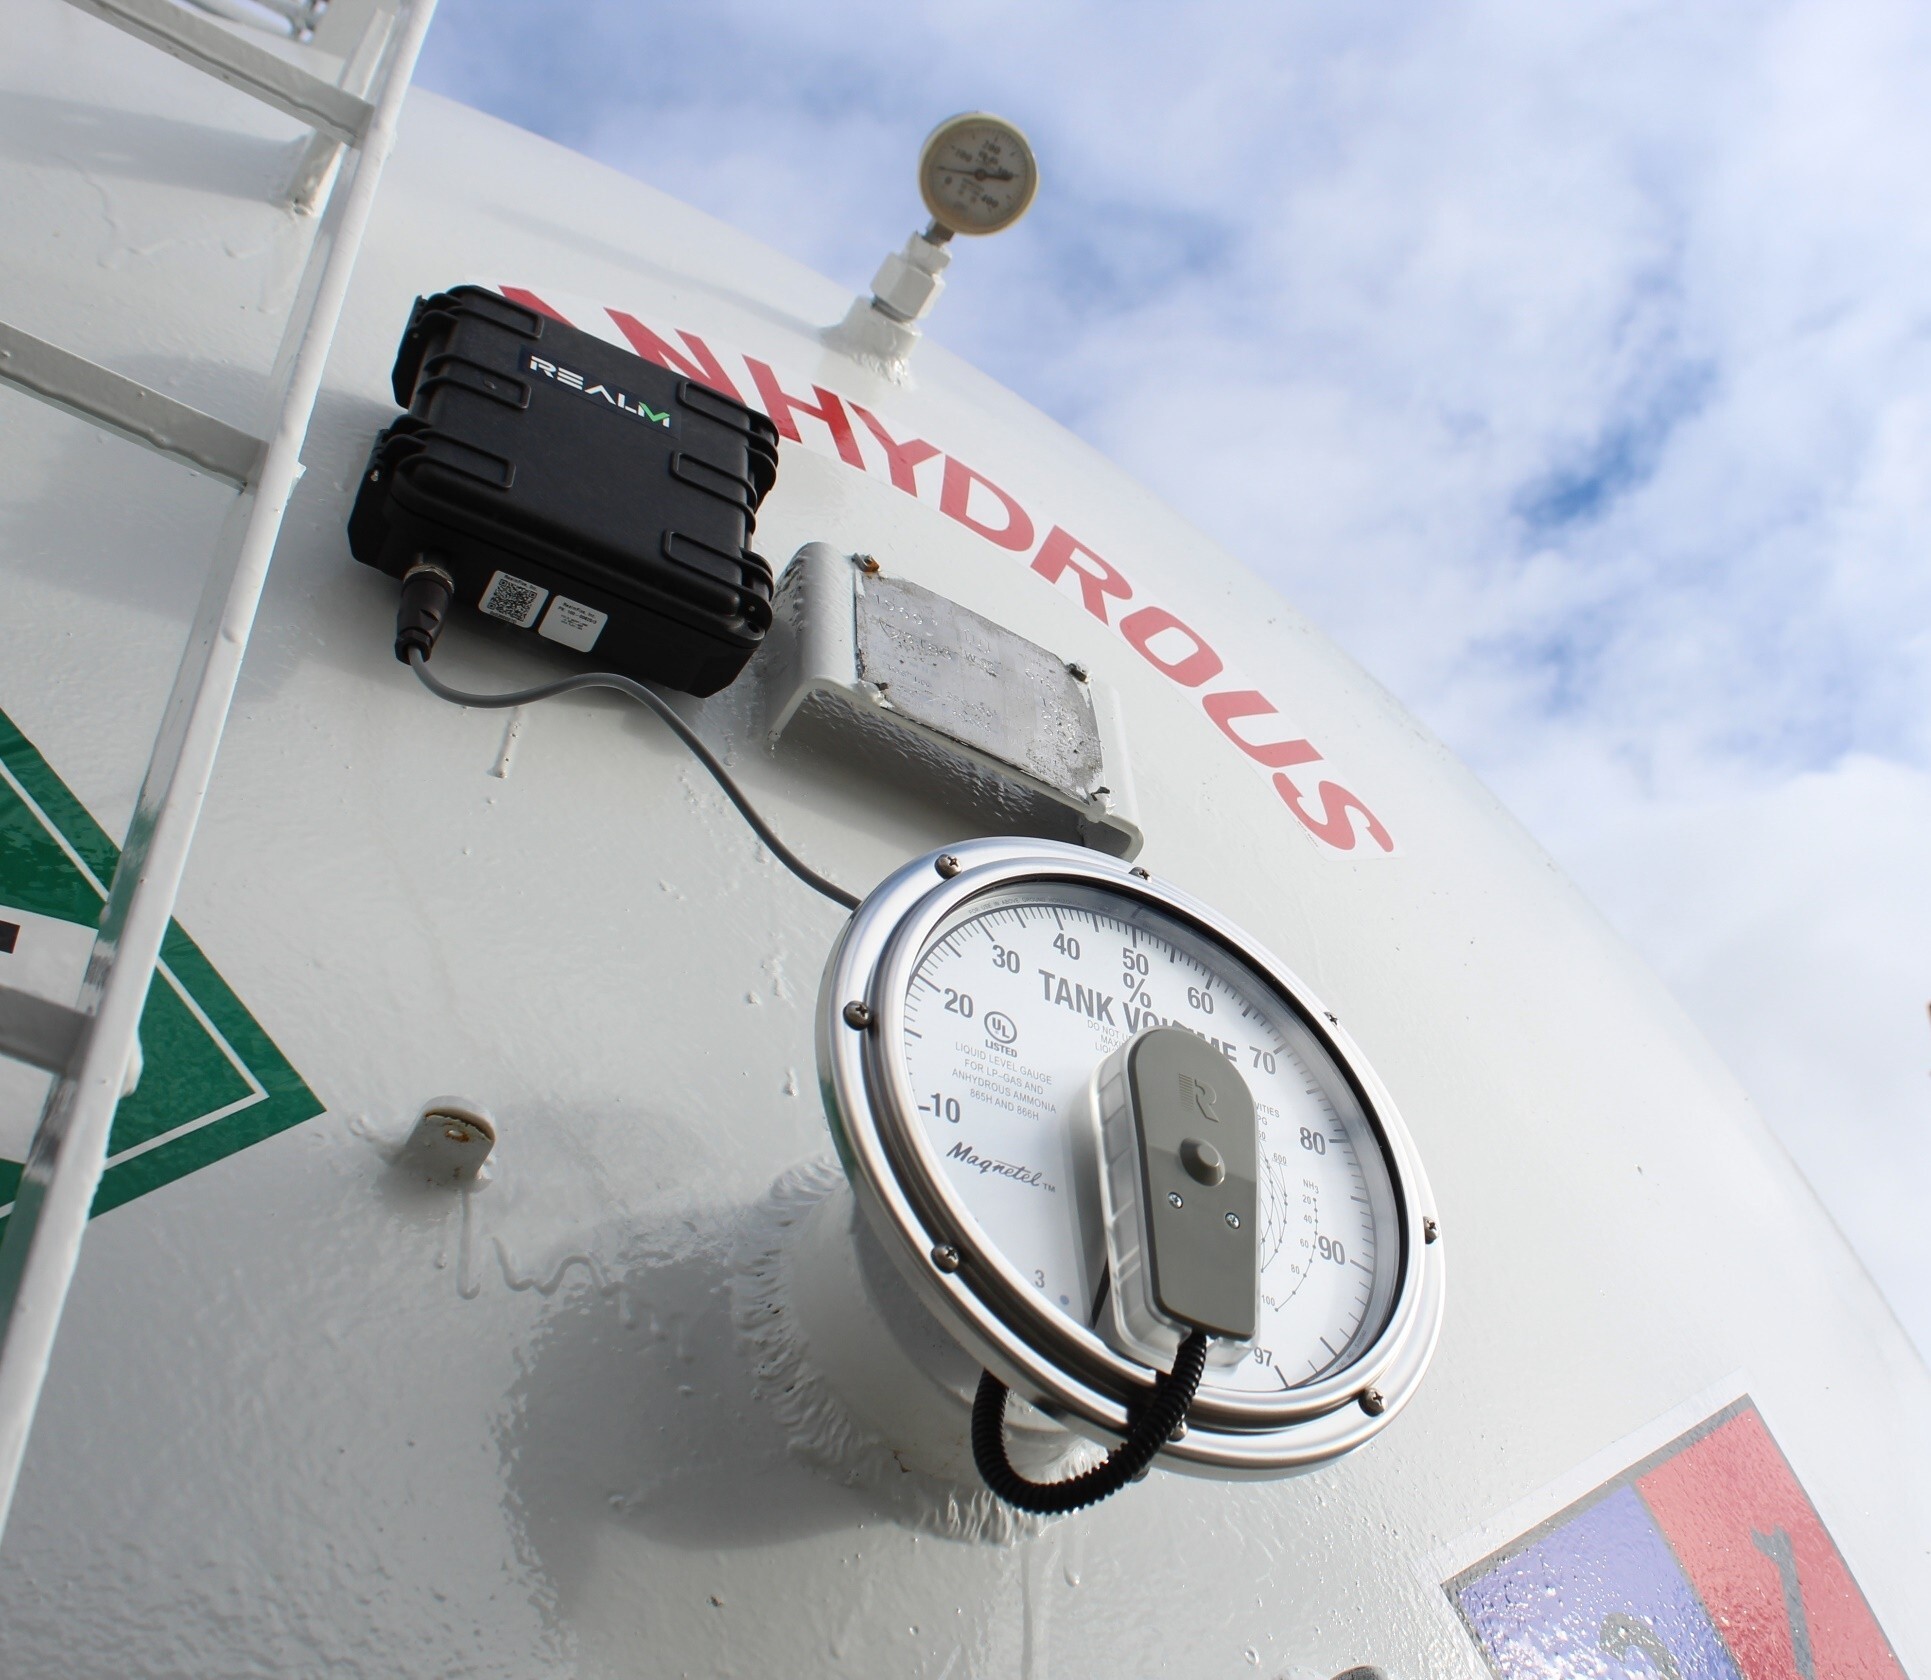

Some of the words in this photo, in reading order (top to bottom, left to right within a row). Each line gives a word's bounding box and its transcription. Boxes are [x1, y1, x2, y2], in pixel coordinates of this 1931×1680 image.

[529, 355, 670, 429] REALM
[497, 284, 1394, 853] NHYDROUS
[992, 944, 1020, 973] 30
[1053, 933, 1080, 960] 40
[1123, 948, 1149, 975] 50
[944, 988, 973, 1018] 20
[1038, 969, 1115, 1027] TANK
[1123, 973, 1152, 1008] %
[1187, 986, 1214, 1014] 60
[1088, 1020, 1099, 1031] DO
[1102, 1026, 1118, 1039] NOT
[985, 1039, 1017, 1058] LISTED
[1249, 1046, 1276, 1075] 70
[955, 1042, 986, 1060] LIQUID
[989, 1055, 1017, 1072] LEVEL
[1019, 1066, 1053, 1085] GAUGE
[964, 1059, 984, 1073] FOR
[986, 1067, 1023, 1087] LP-GAS
[1024, 1081, 1044, 1095] AND
[952, 1068, 1011, 1097] ANHYDROUS
[1013, 1091, 1057, 1114] AMMONIA
[995, 1098, 1014, 1112] AND
[930, 1092, 961, 1124] 10
[1300, 1127, 1326, 1155] 80
[946, 1141, 1043, 1187] Magnetel
[1302, 1195, 1312, 1205] 20
[1303, 1214, 1312, 1224] 40
[1300, 1239, 1309, 1248] 60
[1318, 1236, 1345, 1265] 90
[1034, 1269, 1045, 1288] 3
[1291, 1264, 1300, 1274] 80
[1262, 1295, 1275, 1306] 100
[1254, 1347, 1273, 1367] 97
